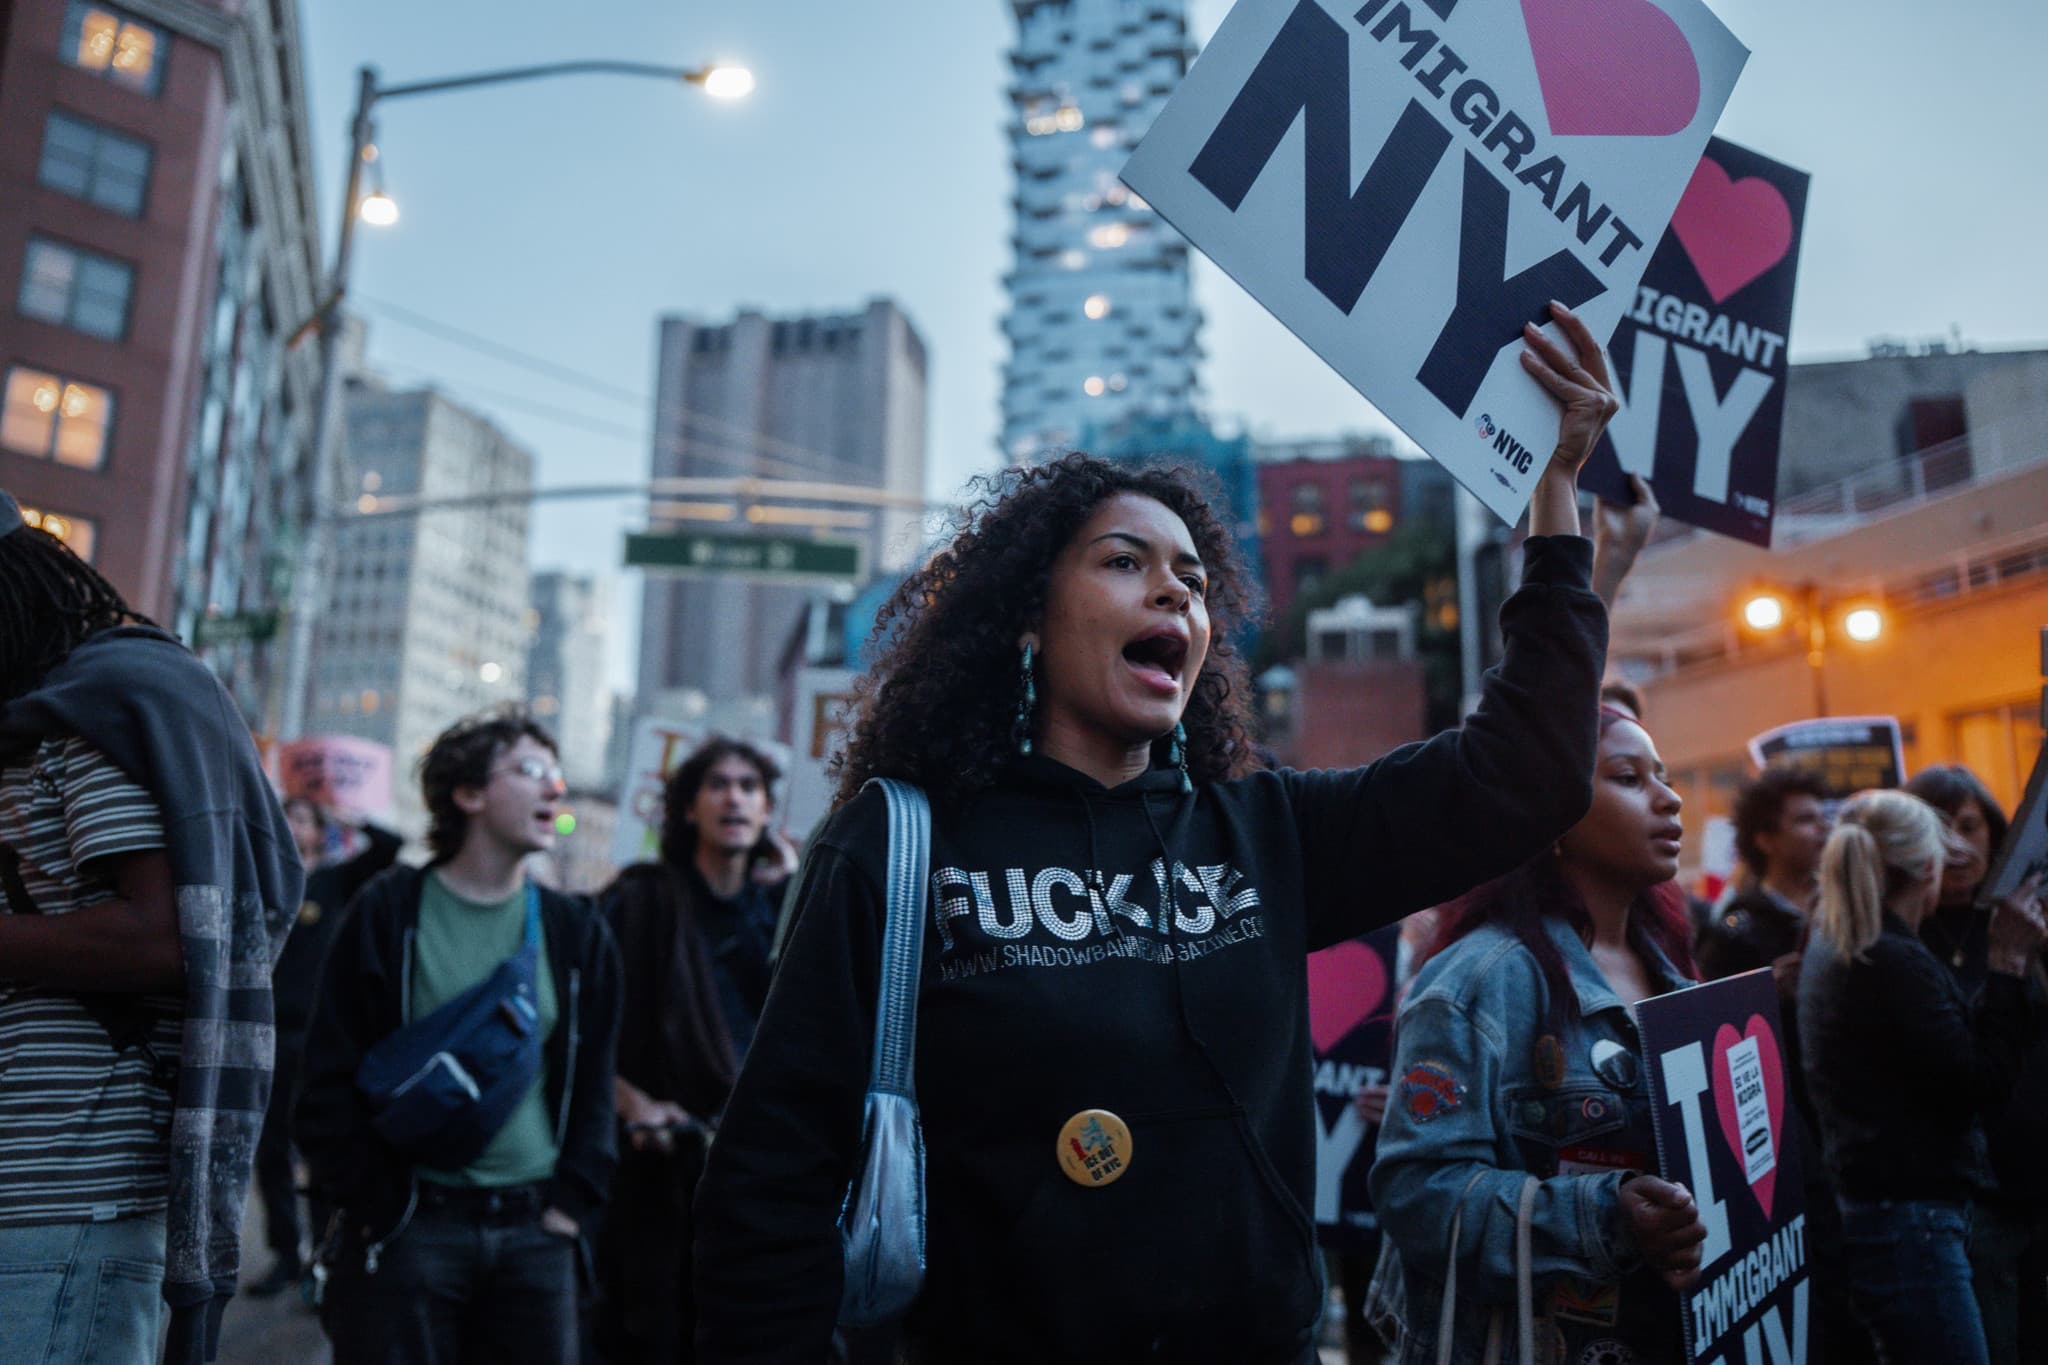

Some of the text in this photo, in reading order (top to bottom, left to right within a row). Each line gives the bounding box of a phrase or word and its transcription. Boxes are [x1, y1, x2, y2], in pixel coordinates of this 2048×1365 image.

[1353, 0, 1644, 267] MIGRANT
[1188, 0, 1608, 420] NY
[1624, 285, 1785, 368] IGRANT
[1492, 428, 1534, 474] NYIC
[931, 856, 1262, 953] FUCK ICE
[1661, 1040, 1732, 1271] I
[1692, 1213, 1805, 1357] IMMIGRANT
